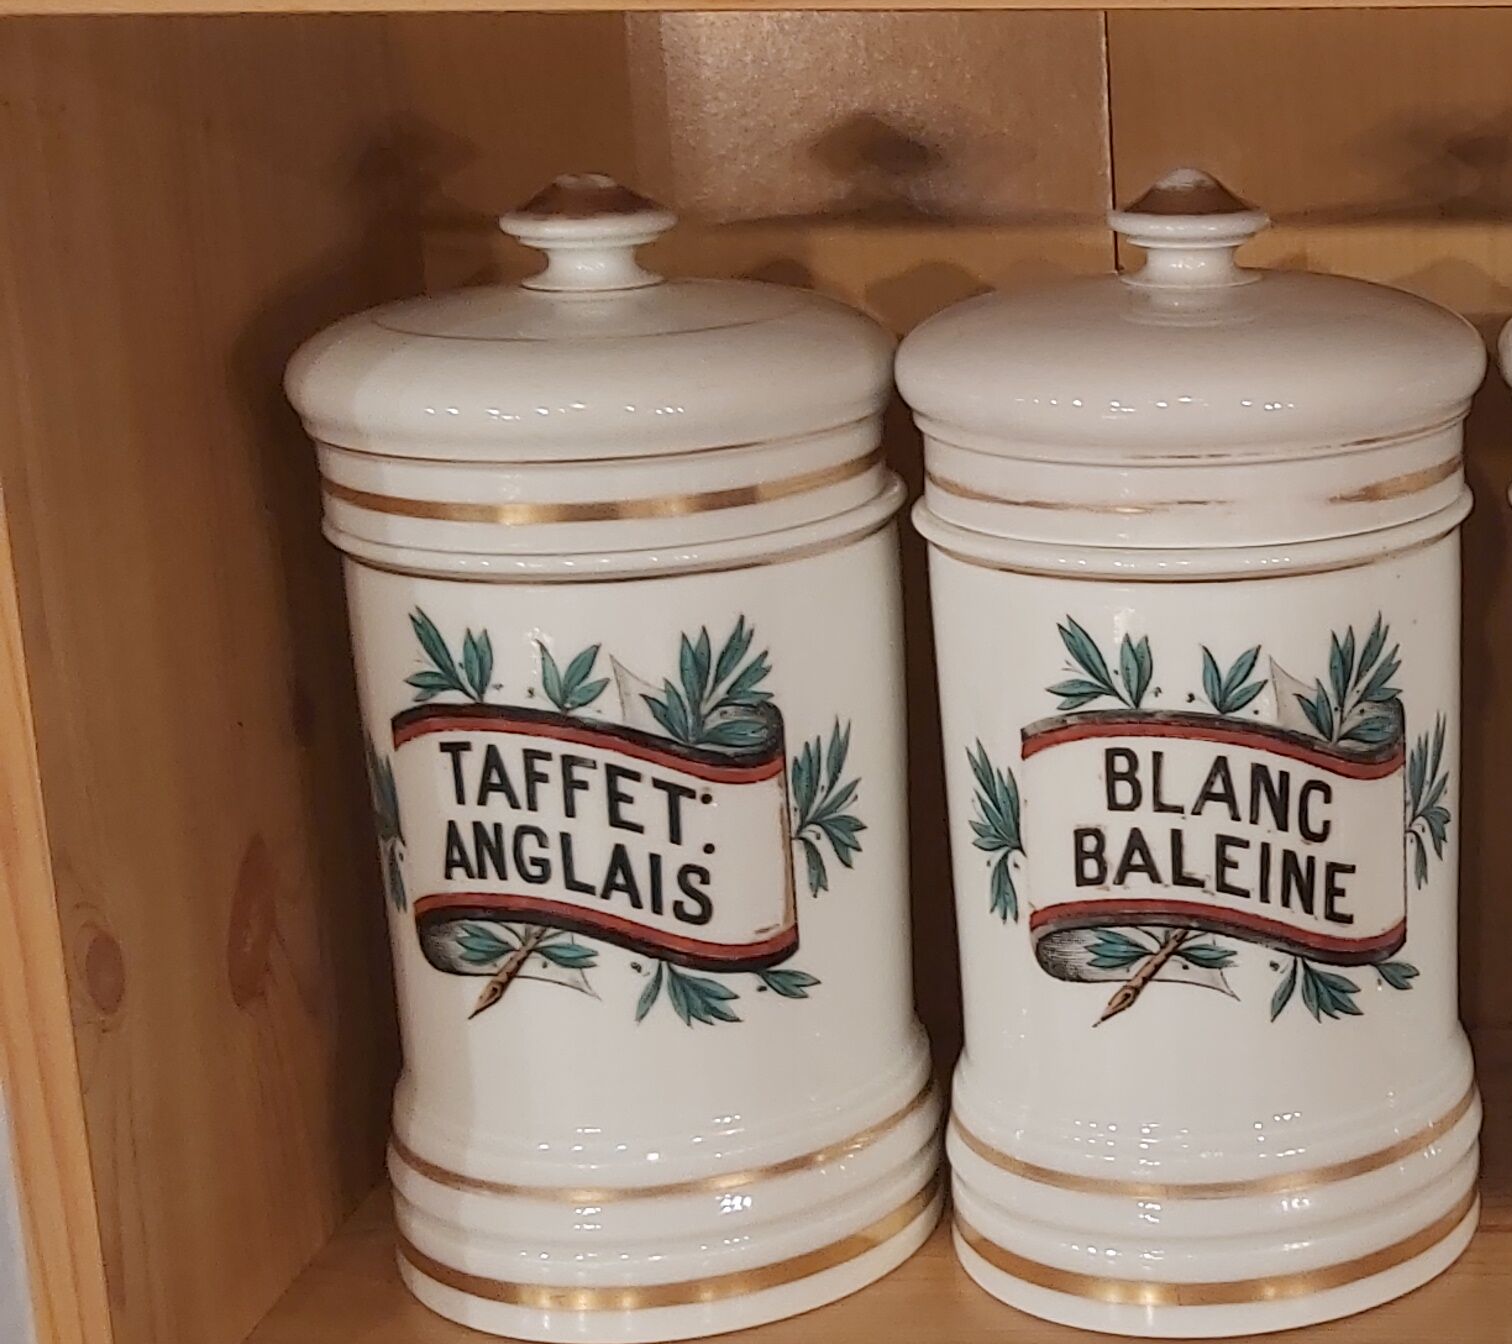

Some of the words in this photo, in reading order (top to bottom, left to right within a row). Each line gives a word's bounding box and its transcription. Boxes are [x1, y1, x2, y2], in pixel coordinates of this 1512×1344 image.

[1104, 747, 1333, 843] BLANC
[445, 820, 713, 925] ANGLAIS
[1074, 827, 1357, 924] BALEINE
